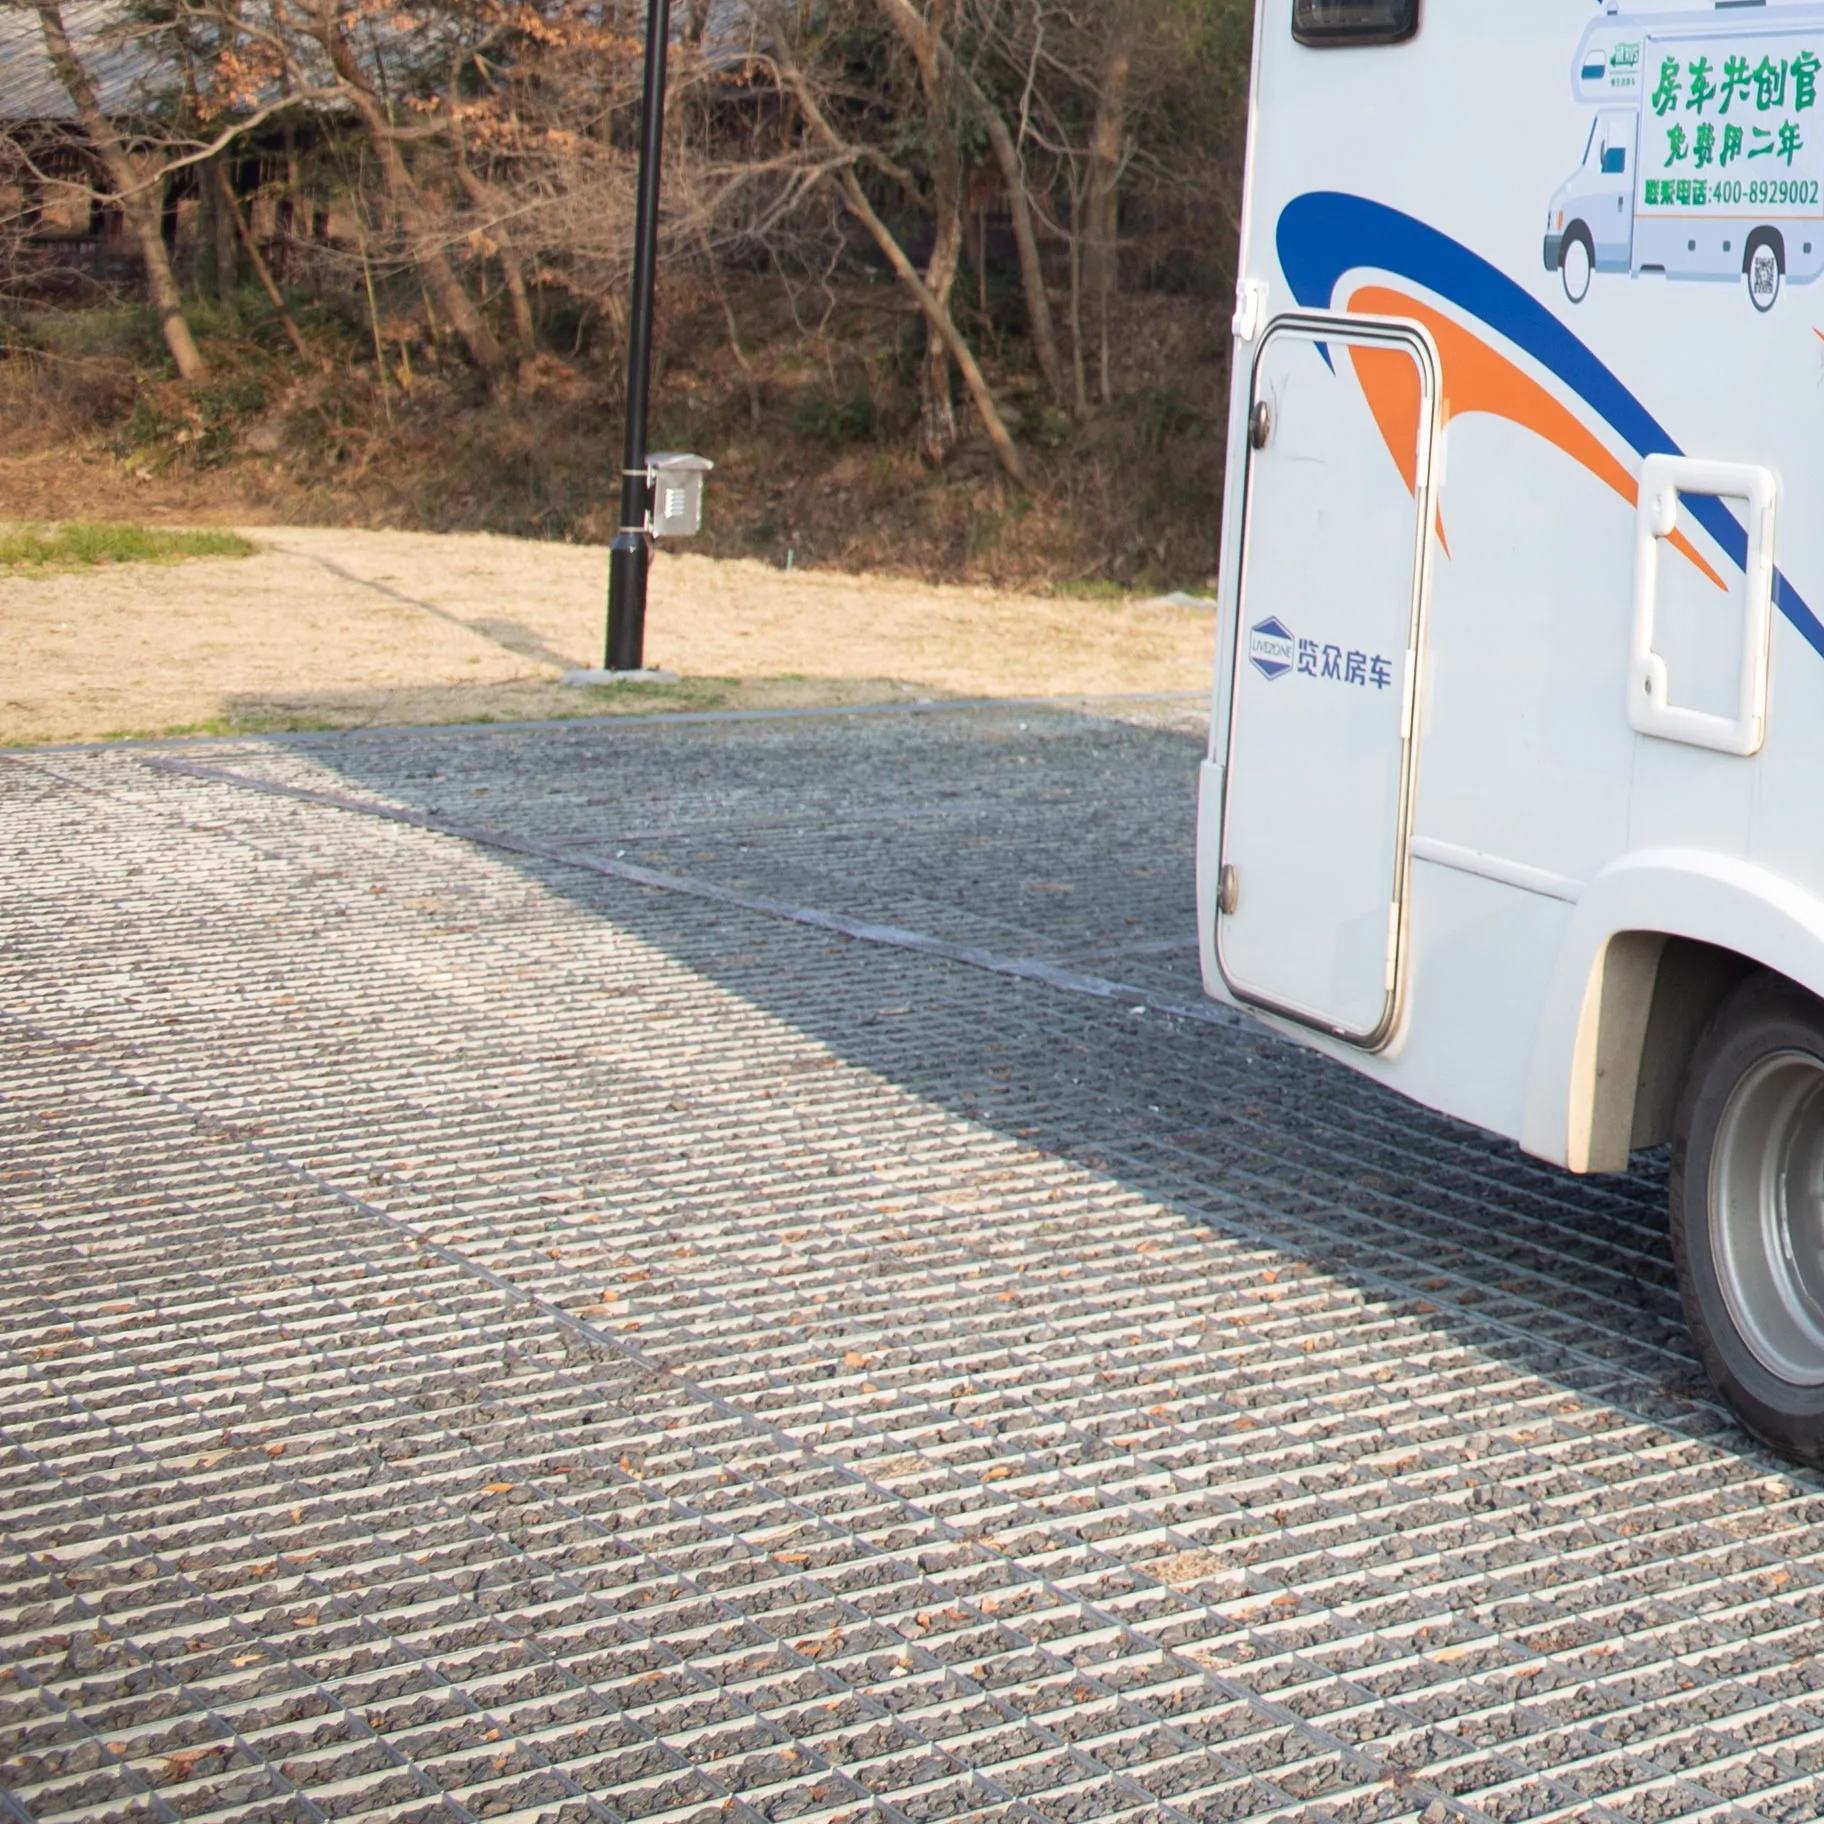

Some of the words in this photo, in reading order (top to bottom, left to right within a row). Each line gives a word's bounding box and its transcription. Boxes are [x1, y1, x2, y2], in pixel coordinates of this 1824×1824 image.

[1652, 50, 1822, 117] 房车共创官
[1664, 119, 1804, 169] 免费用二年
[1297, 637, 1392, 690] 览众房车
